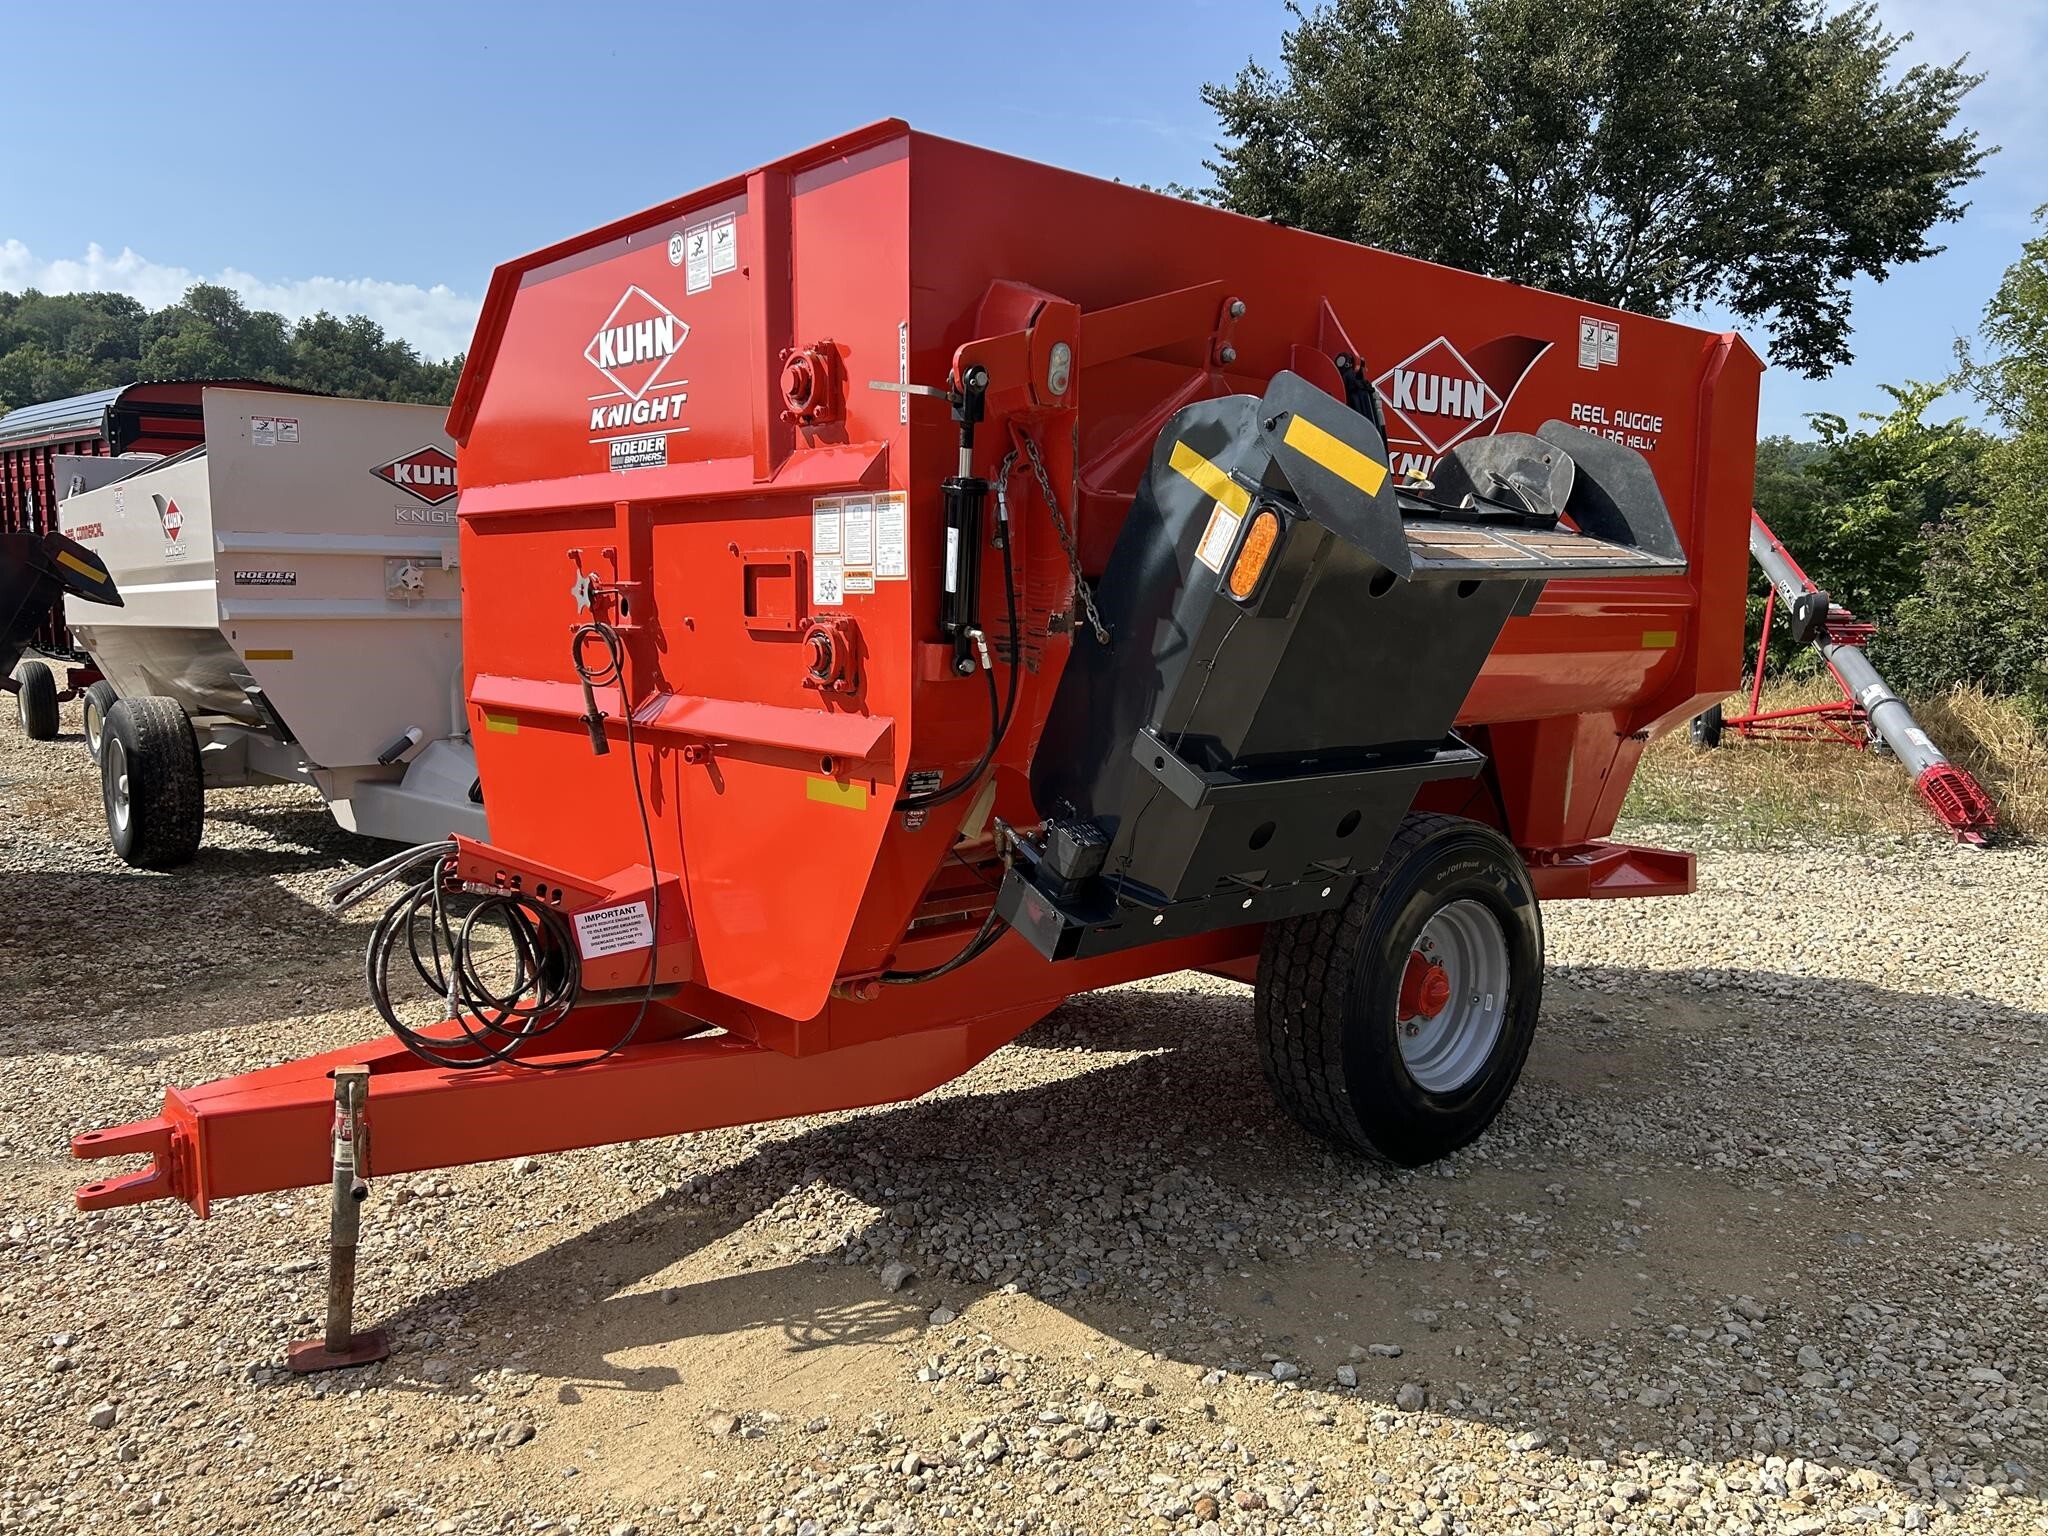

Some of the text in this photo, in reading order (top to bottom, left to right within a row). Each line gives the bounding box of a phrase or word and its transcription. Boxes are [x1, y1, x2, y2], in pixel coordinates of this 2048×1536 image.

[671, 239, 682, 255] 20
[599, 315, 674, 369] KUHN
[1392, 367, 1485, 420] KUHN
[589, 393, 688, 431] KNIGHT
[1570, 402, 1609, 425] REEL
[1613, 410, 1663, 433] AUGGIE
[611, 437, 665, 457] ROEDER
[1626, 434, 1657, 451] HELIX
[624, 451, 662, 464] BROTHERS
[1388, 451, 1443, 476] KNI
[396, 509, 458, 523] KNIGH
[236, 571, 295, 579] ROEDER
[584, 906, 637, 923] IMPORTANT
